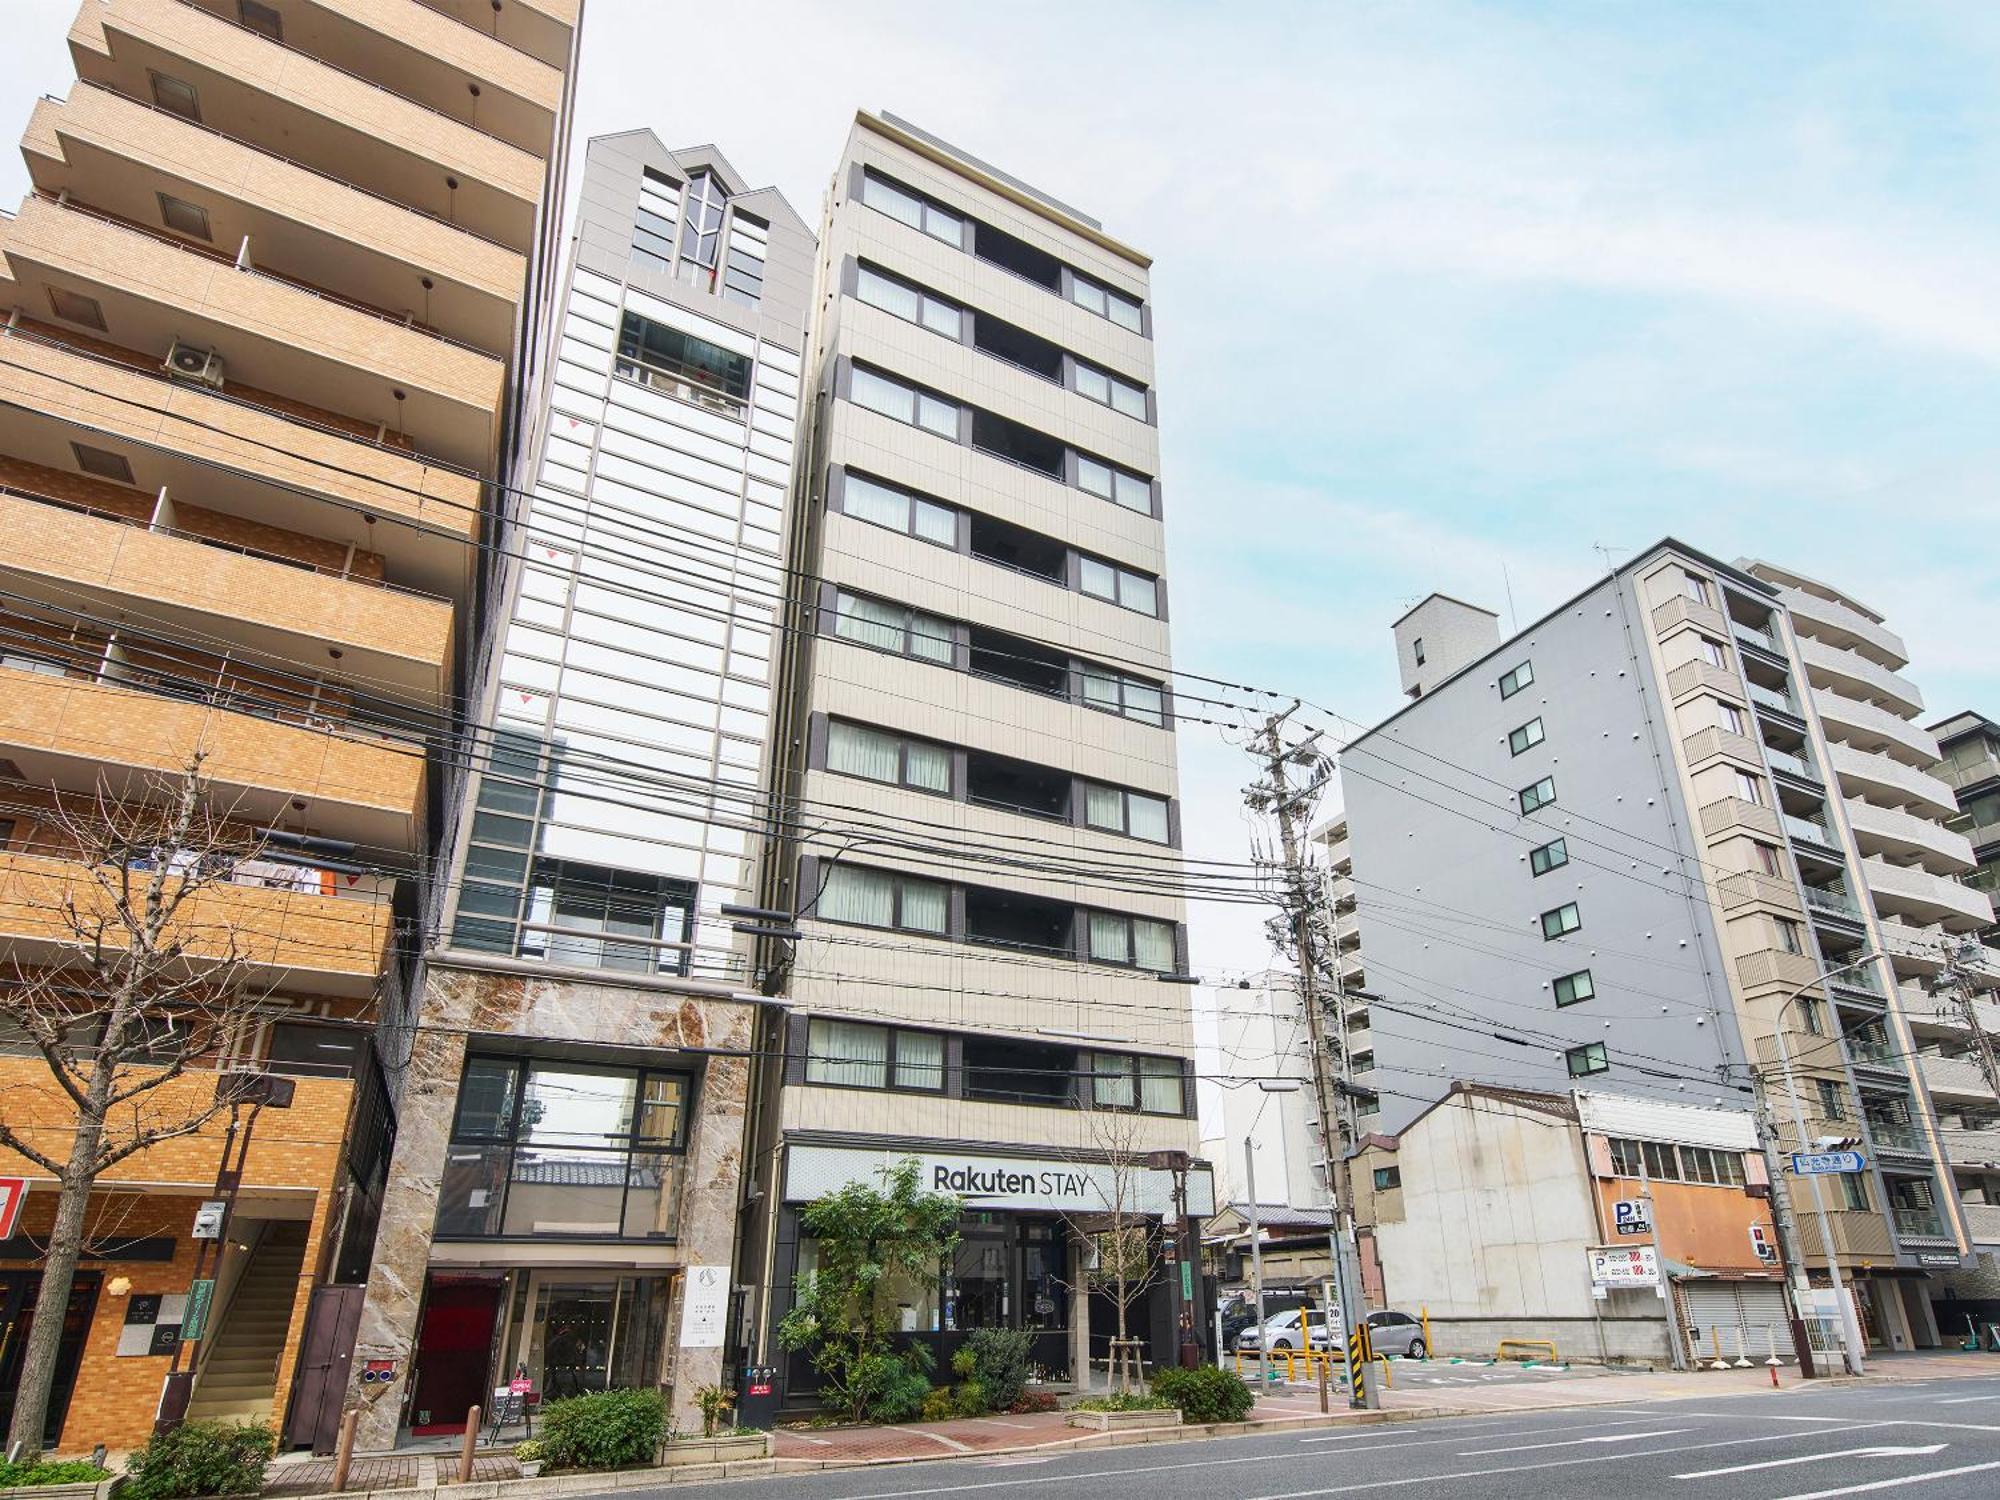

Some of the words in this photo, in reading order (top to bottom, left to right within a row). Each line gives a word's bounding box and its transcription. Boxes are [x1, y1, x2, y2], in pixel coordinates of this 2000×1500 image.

[934, 1165, 1035, 1194] Rakuten
[1040, 1172, 1089, 1196] STAY
[1616, 1203, 1632, 1223] P
[1596, 1258, 1605, 1271] P
